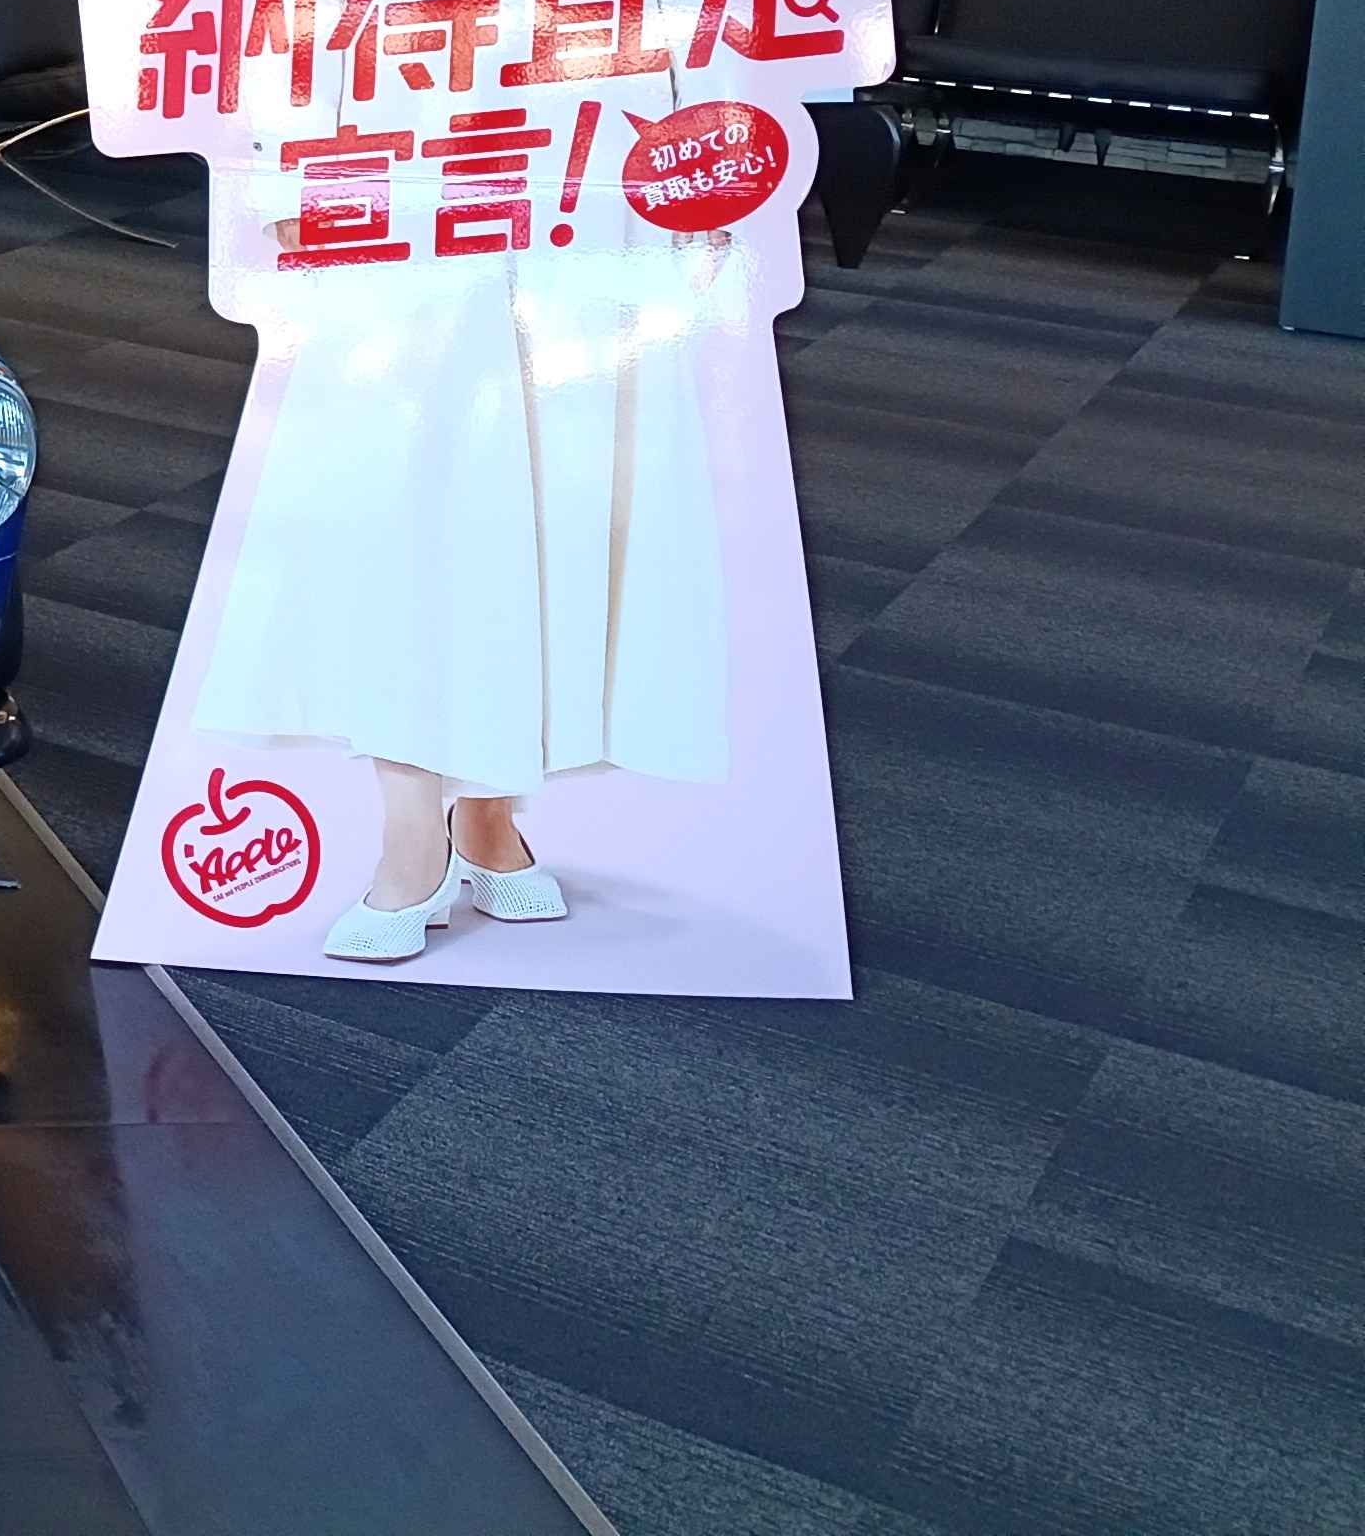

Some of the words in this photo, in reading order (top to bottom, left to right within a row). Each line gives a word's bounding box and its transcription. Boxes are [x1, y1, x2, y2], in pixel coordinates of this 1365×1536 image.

[640, 145, 777, 211] 買取も安心!
[648, 123, 749, 172] 初めての
[277, 100, 602, 272] 宣言!
